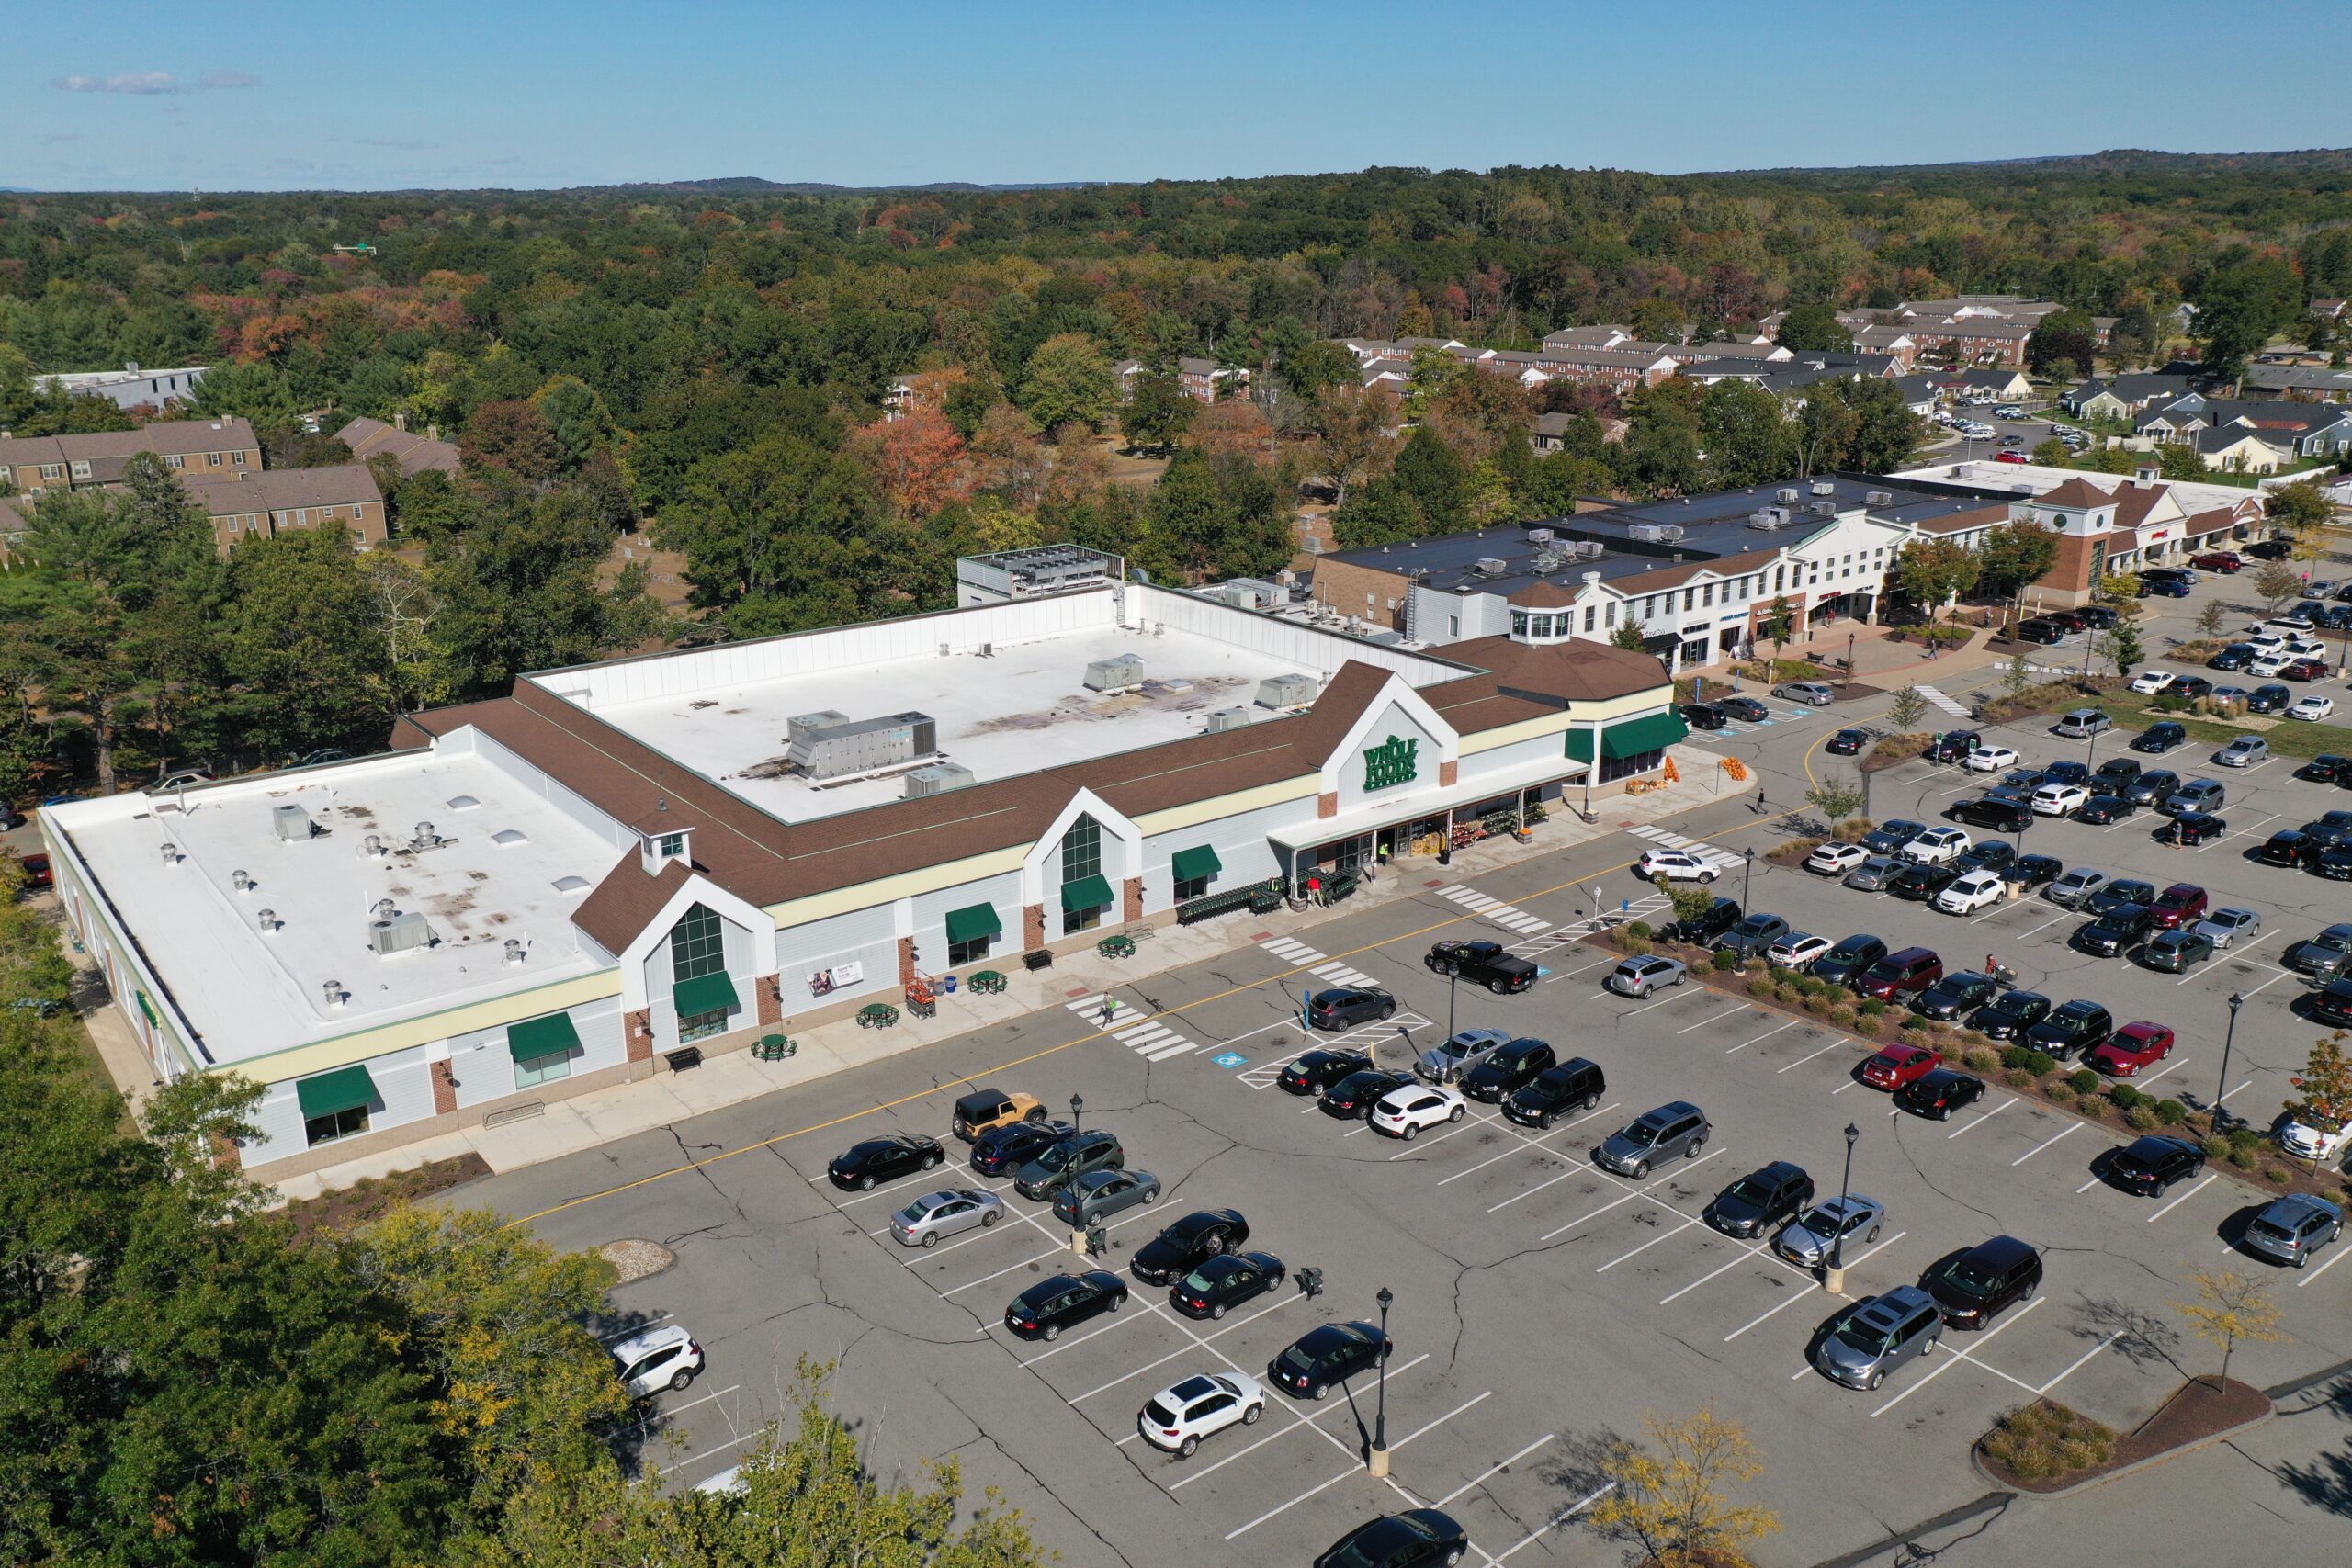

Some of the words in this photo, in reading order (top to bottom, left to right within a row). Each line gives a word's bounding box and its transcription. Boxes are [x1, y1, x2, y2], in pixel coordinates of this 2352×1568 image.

[1363, 738, 1419, 765] WHOLE
[1366, 754, 1417, 782] FOODS
[1370, 773, 1412, 789] MARKET
